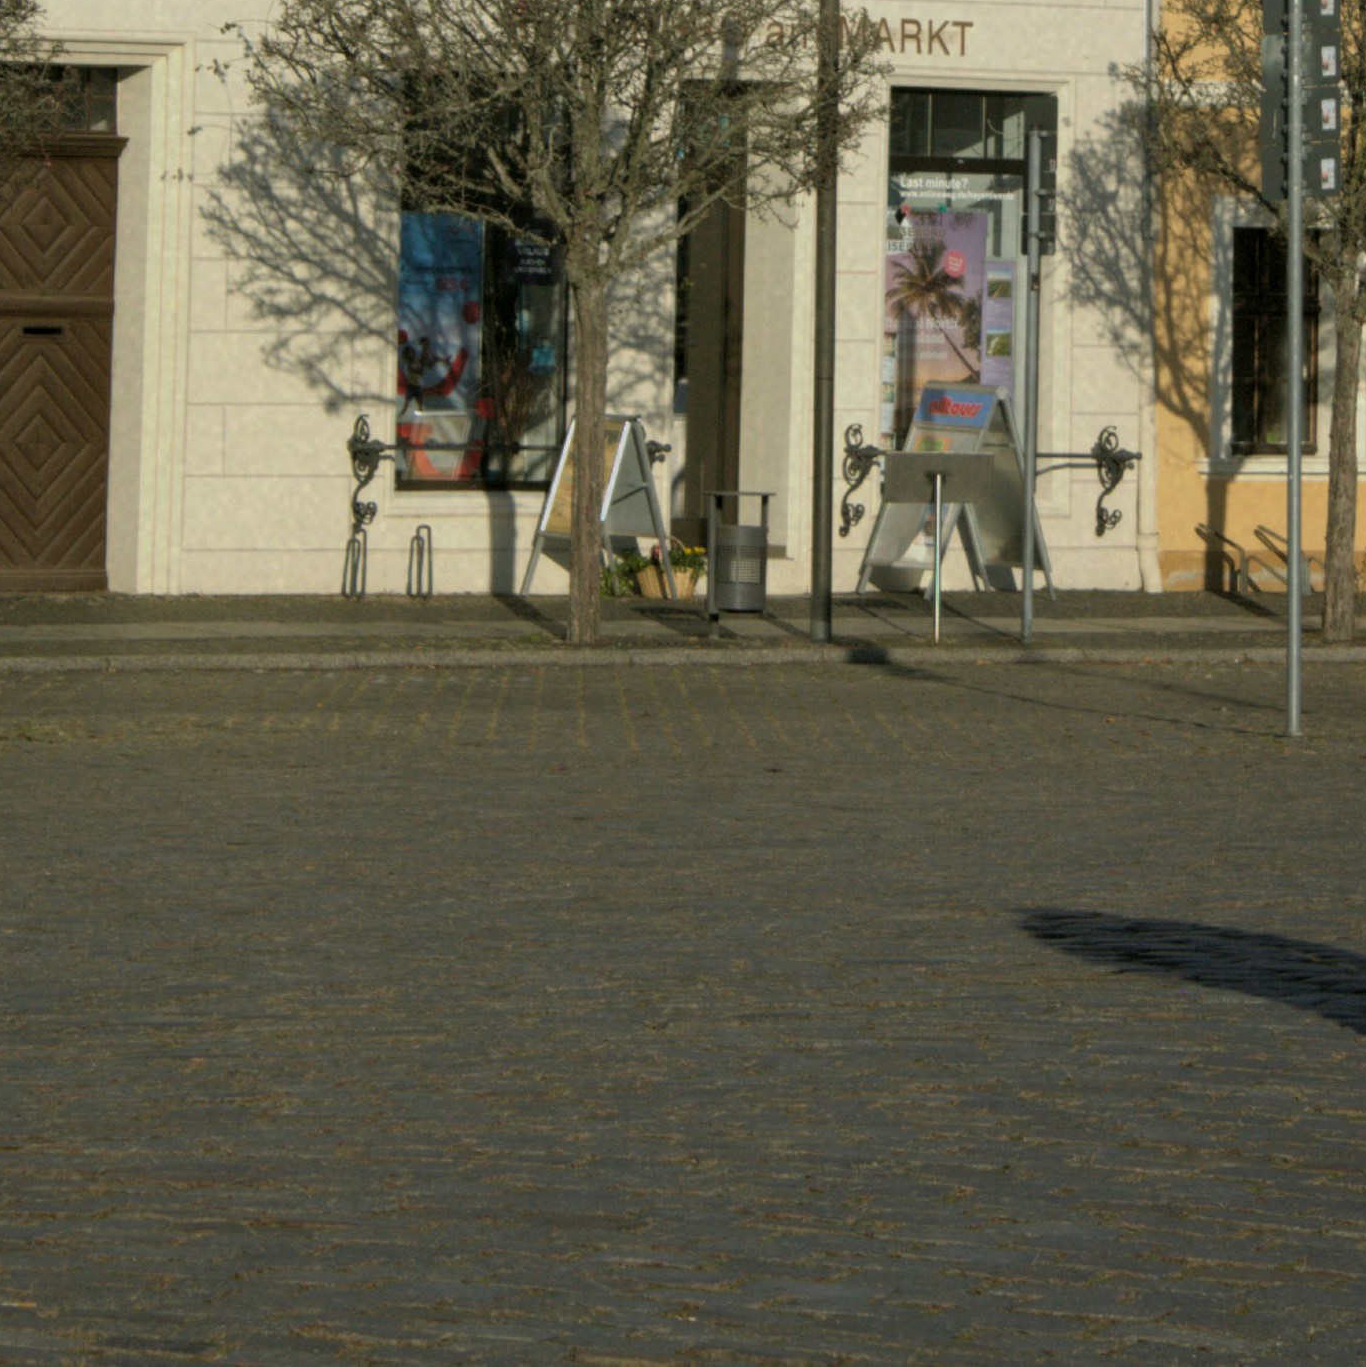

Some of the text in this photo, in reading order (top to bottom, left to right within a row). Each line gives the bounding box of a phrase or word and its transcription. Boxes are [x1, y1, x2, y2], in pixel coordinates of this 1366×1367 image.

[836, 15, 974, 57] MARKT
[900, 176, 968, 190] Last minute?
